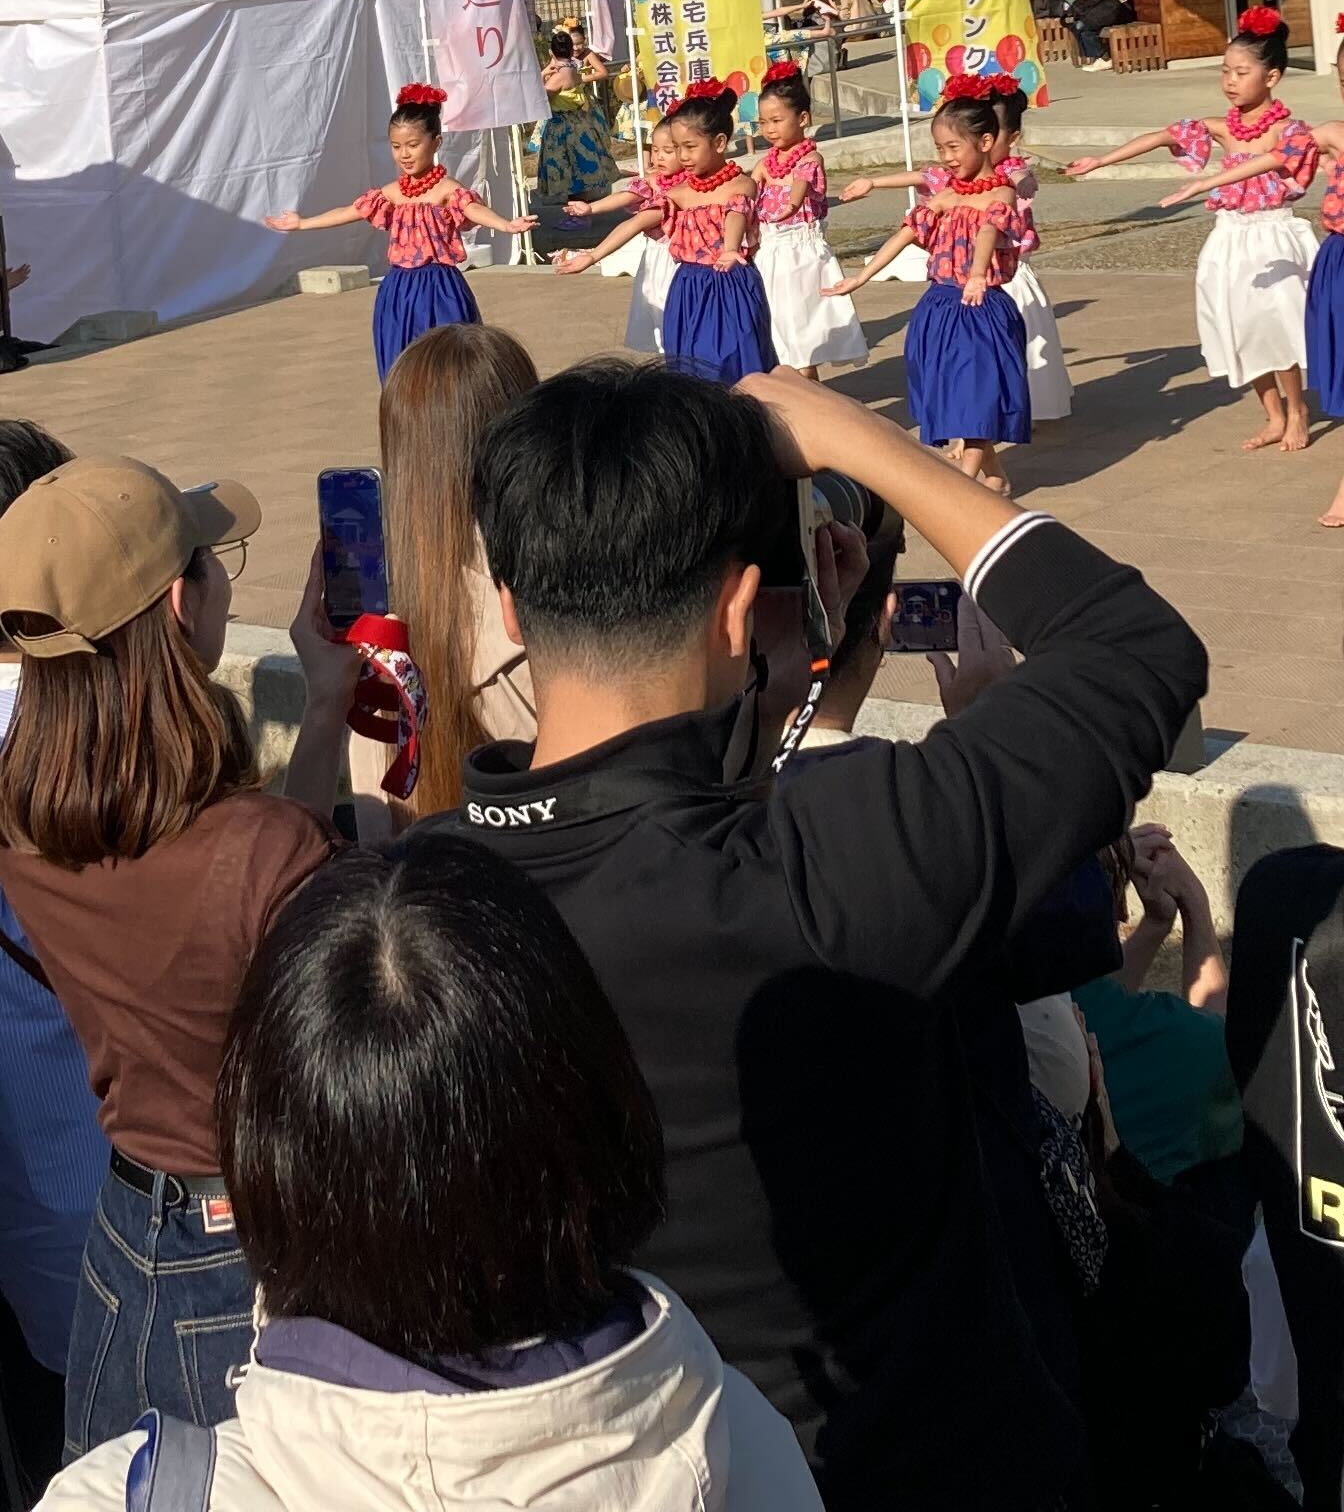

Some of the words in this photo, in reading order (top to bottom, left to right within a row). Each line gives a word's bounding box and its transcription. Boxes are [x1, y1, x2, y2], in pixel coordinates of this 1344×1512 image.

[650, 3, 680, 113] 株式会社
[771, 680, 823, 773] SONY
[467, 796, 557, 828] SONY
